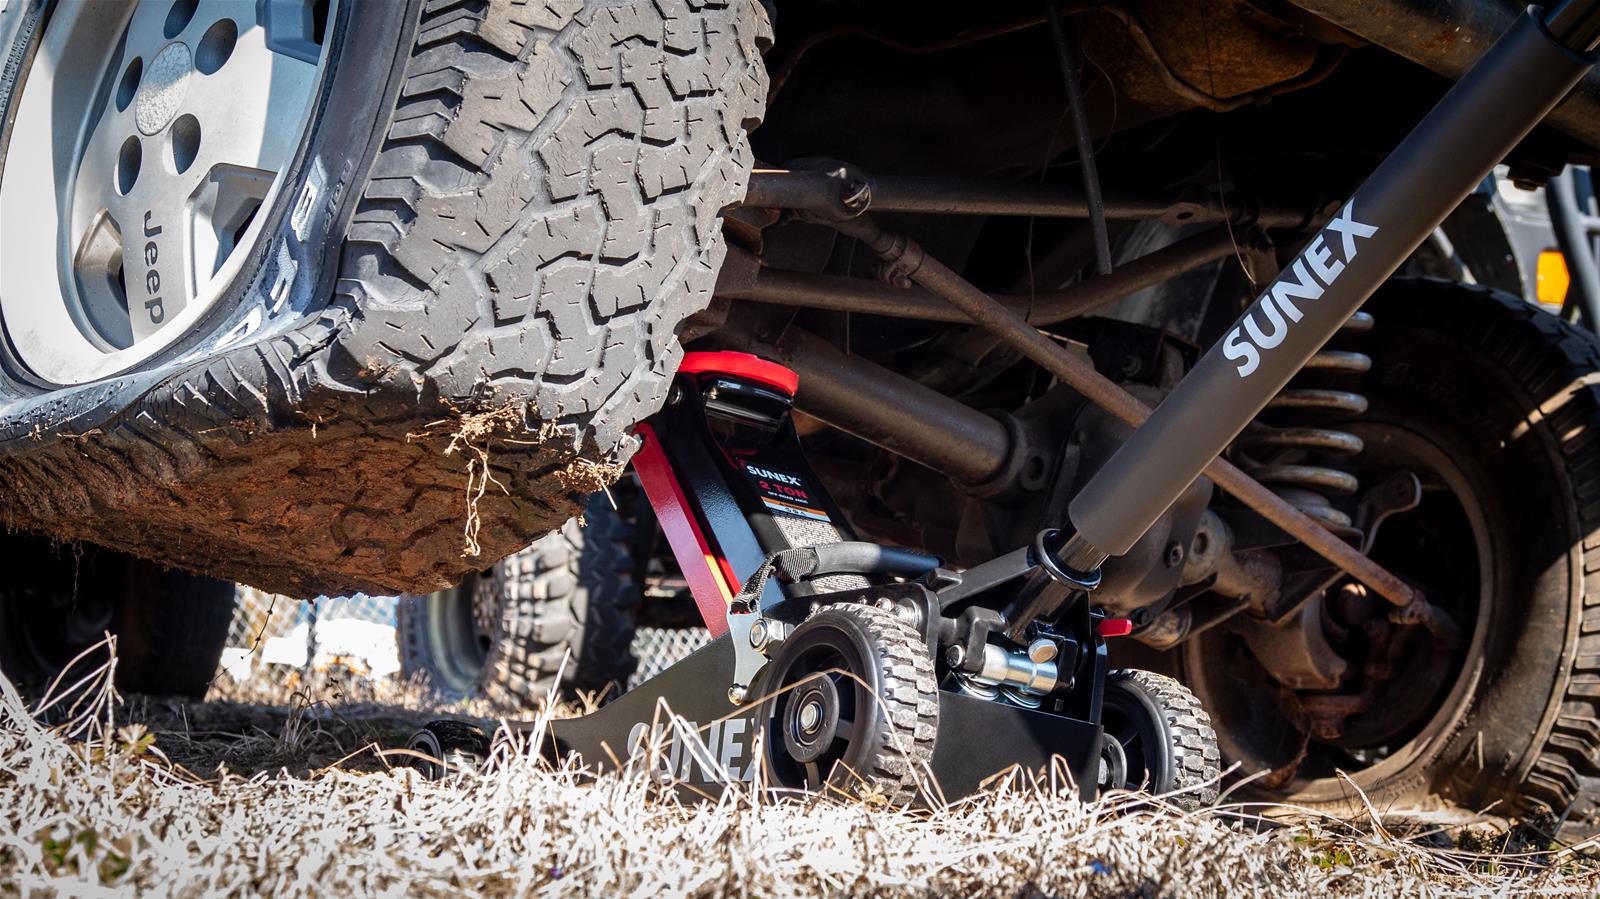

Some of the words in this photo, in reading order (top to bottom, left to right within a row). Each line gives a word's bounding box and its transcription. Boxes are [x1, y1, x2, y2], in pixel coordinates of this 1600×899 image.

[143, 209, 164, 324] Jeep
[1222, 197, 1379, 378] SUNEX
[746, 465, 801, 486] SUNEX
[758, 480, 771, 490] 2
[772, 483, 808, 499] TON
[627, 717, 757, 785] SUNE
